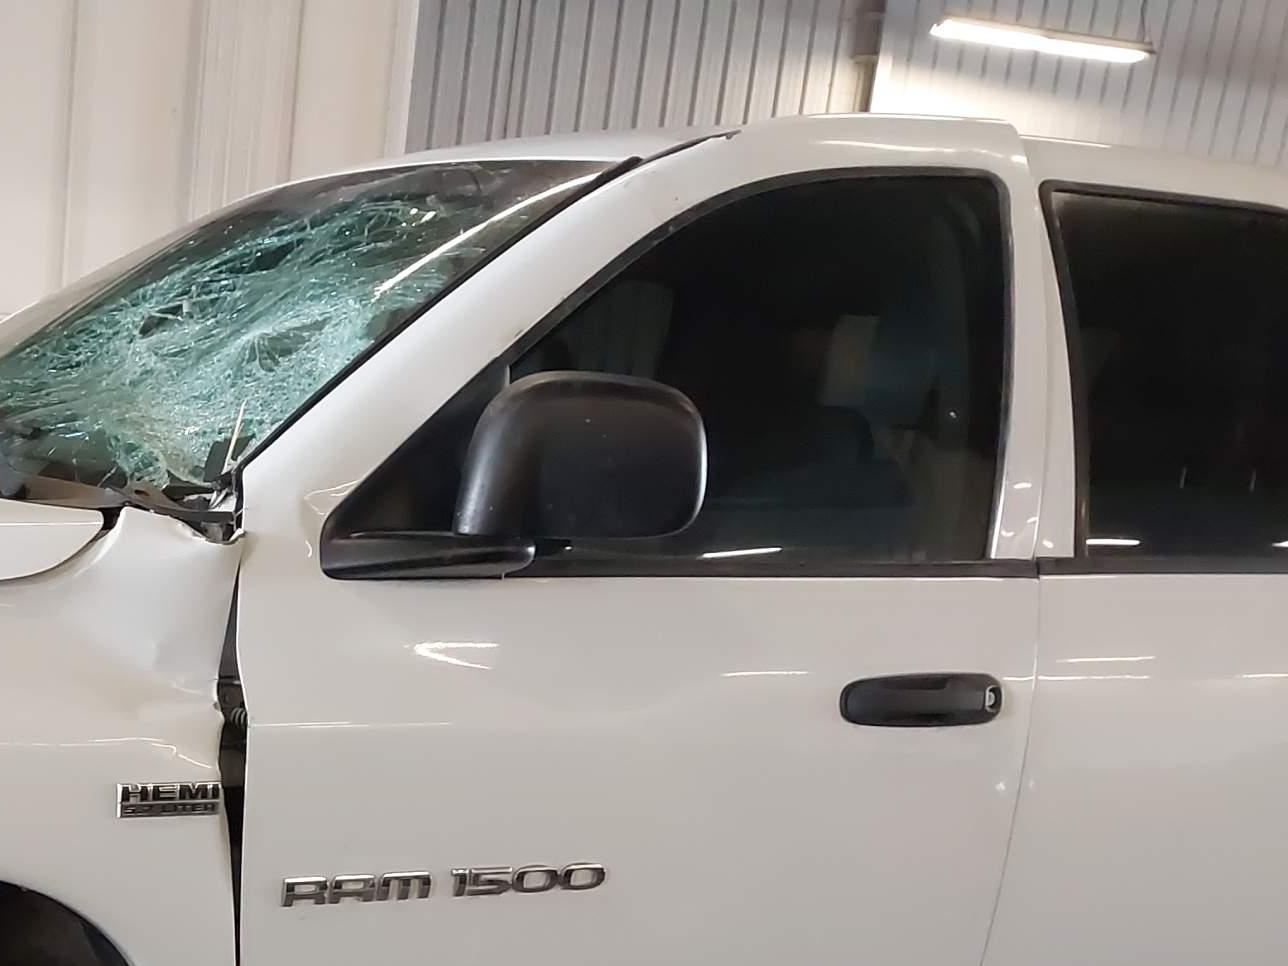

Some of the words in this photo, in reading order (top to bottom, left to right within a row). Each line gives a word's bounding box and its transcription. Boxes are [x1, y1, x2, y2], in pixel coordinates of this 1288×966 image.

[117, 782, 220, 803] HEMI
[281, 870, 432, 907] RAM
[450, 862, 607, 898] 1500
